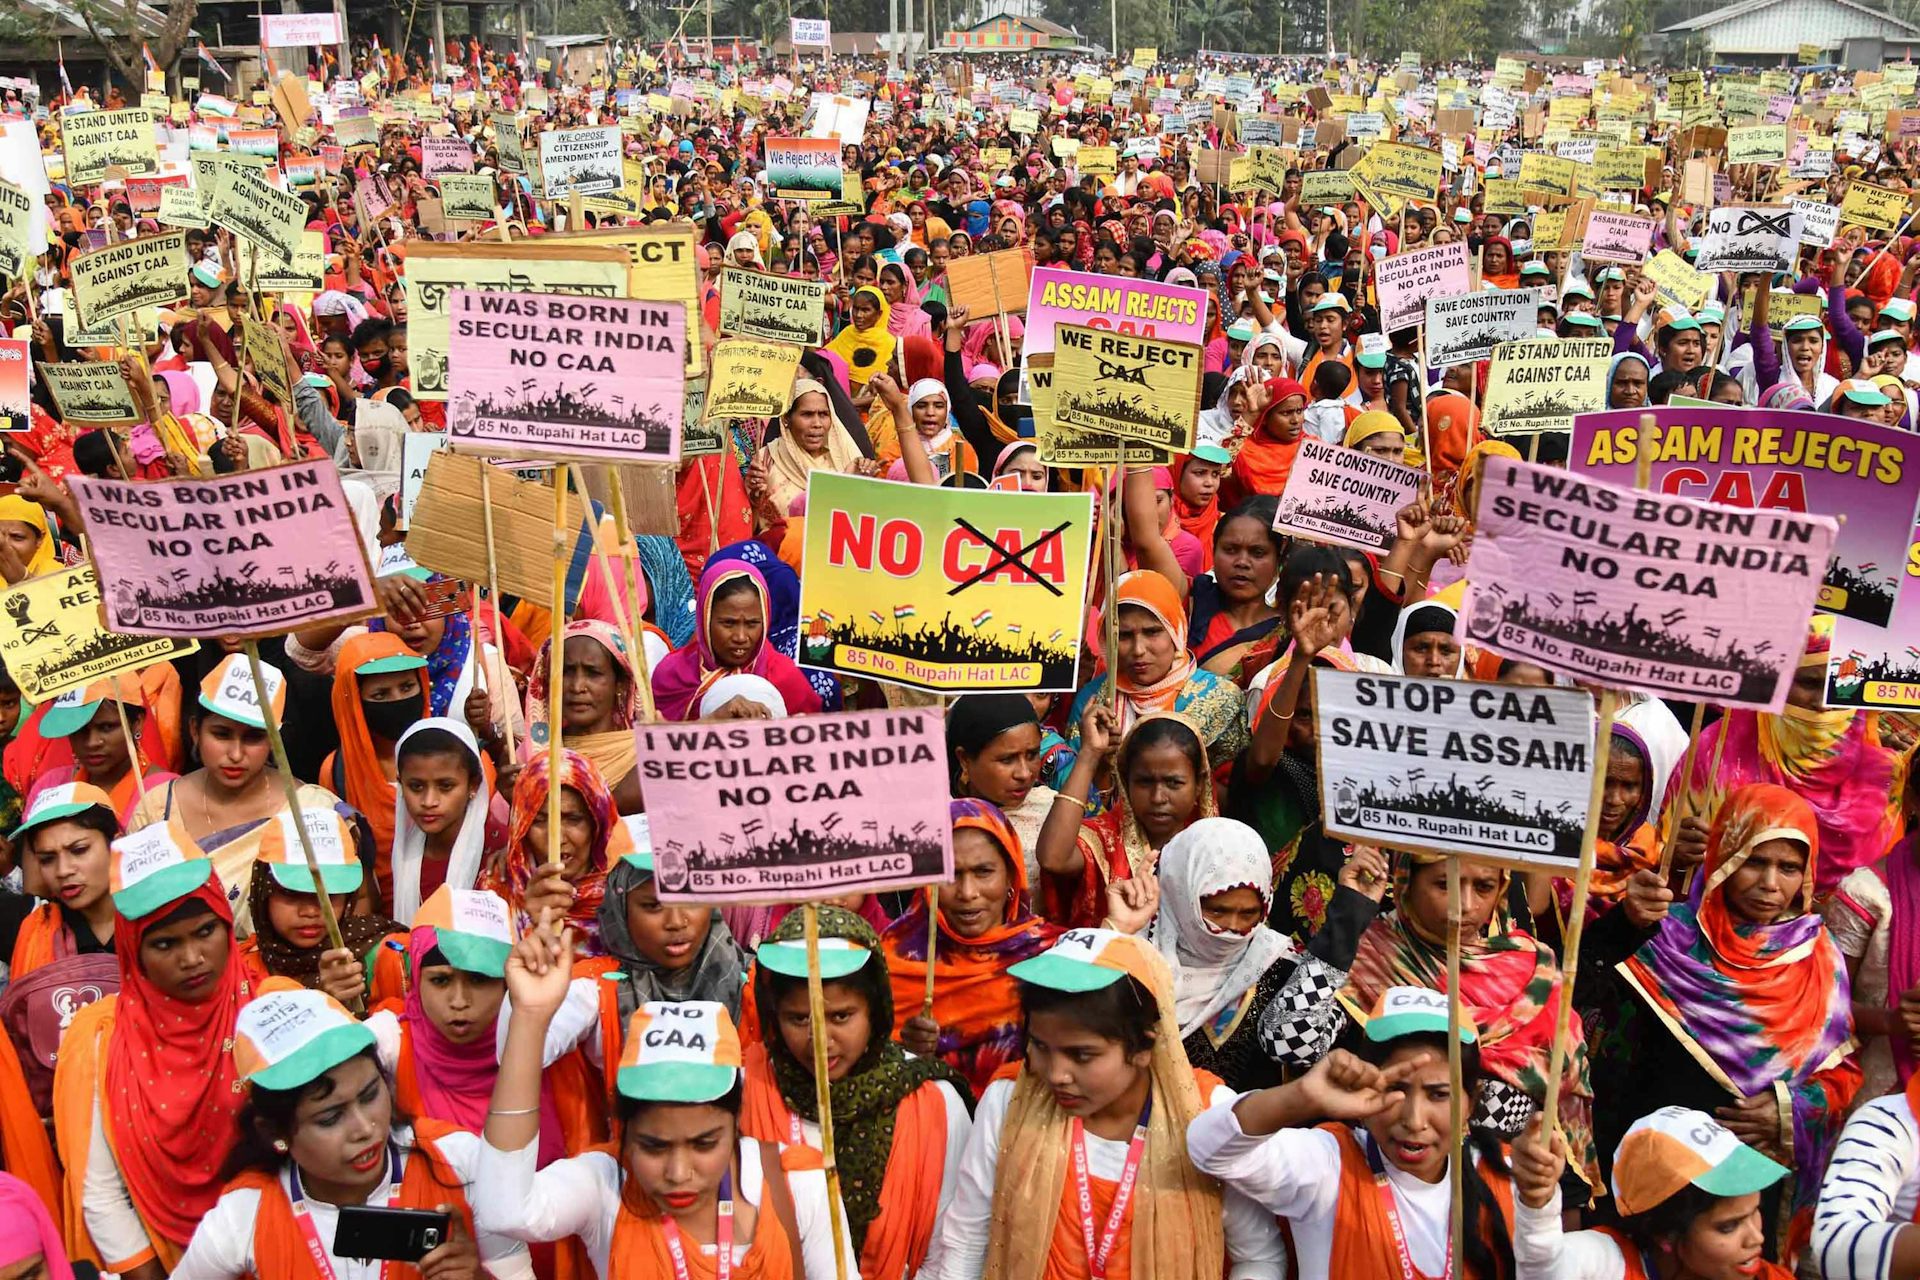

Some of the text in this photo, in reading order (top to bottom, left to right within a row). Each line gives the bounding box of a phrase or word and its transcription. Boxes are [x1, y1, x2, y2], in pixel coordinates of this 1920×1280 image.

[74, 112, 149, 130] STAND UNITED
[558, 130, 605, 142] WE OPPOSE
[72, 129, 139, 148] AGAINST CAA
[553, 140, 609, 153] CITIZENSHIP
[545, 149, 619, 164] AMENDMENT ACT
[769, 150, 784, 165] We
[785, 150, 812, 168] Reject
[231, 180, 292, 226] AGAINST CAA
[241, 169, 271, 196] STAND
[271, 186, 305, 216] UNITED
[1852, 184, 1907, 203] WE REJECT
[1866, 197, 1886, 207] CAA
[1592, 214, 1652, 230] ASSAM REJECTS
[1805, 213, 1836, 227] ASSAM
[1814, 203, 1832, 216] CAA
[1709, 214, 1791, 238] NO CAA
[75, 237, 182, 275] WE STAND UNITED
[1385, 257, 1409, 271] WAS
[1411, 249, 1444, 264] BORN
[1448, 245, 1462, 257] IN
[91, 256, 170, 287] AGAINST CAA
[727, 271, 822, 297] WE STAND UNITED
[1378, 257, 1465, 286] SECULAR INDIA
[1397, 273, 1441, 291] NO CAA
[463, 294, 471, 312] I
[480, 296, 539, 317] WAS
[547, 301, 629, 325] BORN
[640, 308, 670, 328] IN
[738, 288, 808, 312] AGAINST CAA
[1040, 280, 1199, 326] ASSAM REJECTS
[1434, 293, 1531, 314] SAVE CONSTITUTION
[1445, 310, 1517, 328] SAVE COUNTRY
[458, 319, 676, 354] SECULAR INDIA
[1061, 328, 1194, 369] WE REJECT
[1497, 341, 1612, 362] WE STAND UNITED
[56, 366, 83, 378] STAND
[85, 364, 119, 377] UNITED
[510, 348, 617, 374] NO CAA
[1098, 358, 1148, 386] CAA
[1505, 365, 1592, 385] AGAINST CAA
[59, 379, 114, 391] AGAINST CAA
[478, 418, 642, 446] 85 No. Rupahi Hat LAC
[1302, 442, 1421, 489] SAVE CONSTITUTION
[1585, 424, 1905, 486] ASSAM REJECTS
[81, 468, 319, 509] I WAS BORN IN
[1308, 467, 1400, 506] SAVE COUNTRY
[1659, 466, 1811, 513] CAA
[87, 492, 336, 534] SECULAR INDIA
[1505, 466, 1816, 545] I WAS BORN IN
[146, 530, 275, 559] NO CAA
[827, 507, 1068, 586] NO CAA
[1491, 495, 1812, 578] SECULAR INDIA
[1560, 545, 1719, 600] NO CAA
[143, 592, 329, 627] 85 No. Rupahi Hat LAC
[3, 620, 61, 652] NO CAA
[845, 648, 1031, 684] 85 No. Rupahi Hat LAC
[1501, 624, 1735, 691] 85 No. Rupahi Hat LAC
[1355, 677, 1556, 726] STOP CAA
[644, 715, 925, 752] I WAS BORN IN
[1331, 717, 1587, 773] SAVE ASSAM
[643, 743, 937, 782] SECULAR INDIA
[718, 779, 864, 809] NO CAA
[1362, 809, 1549, 847] 85 No. Rupahi Hat LAC
[691, 856, 907, 888] 85 No. Rupahi Hat LAC
[660, 1005, 704, 1019] NO
[645, 1028, 706, 1052] CAA
[1073, 1142, 1093, 1214] COLLEGE
[1108, 1162, 1138, 1230] COLLEGE
